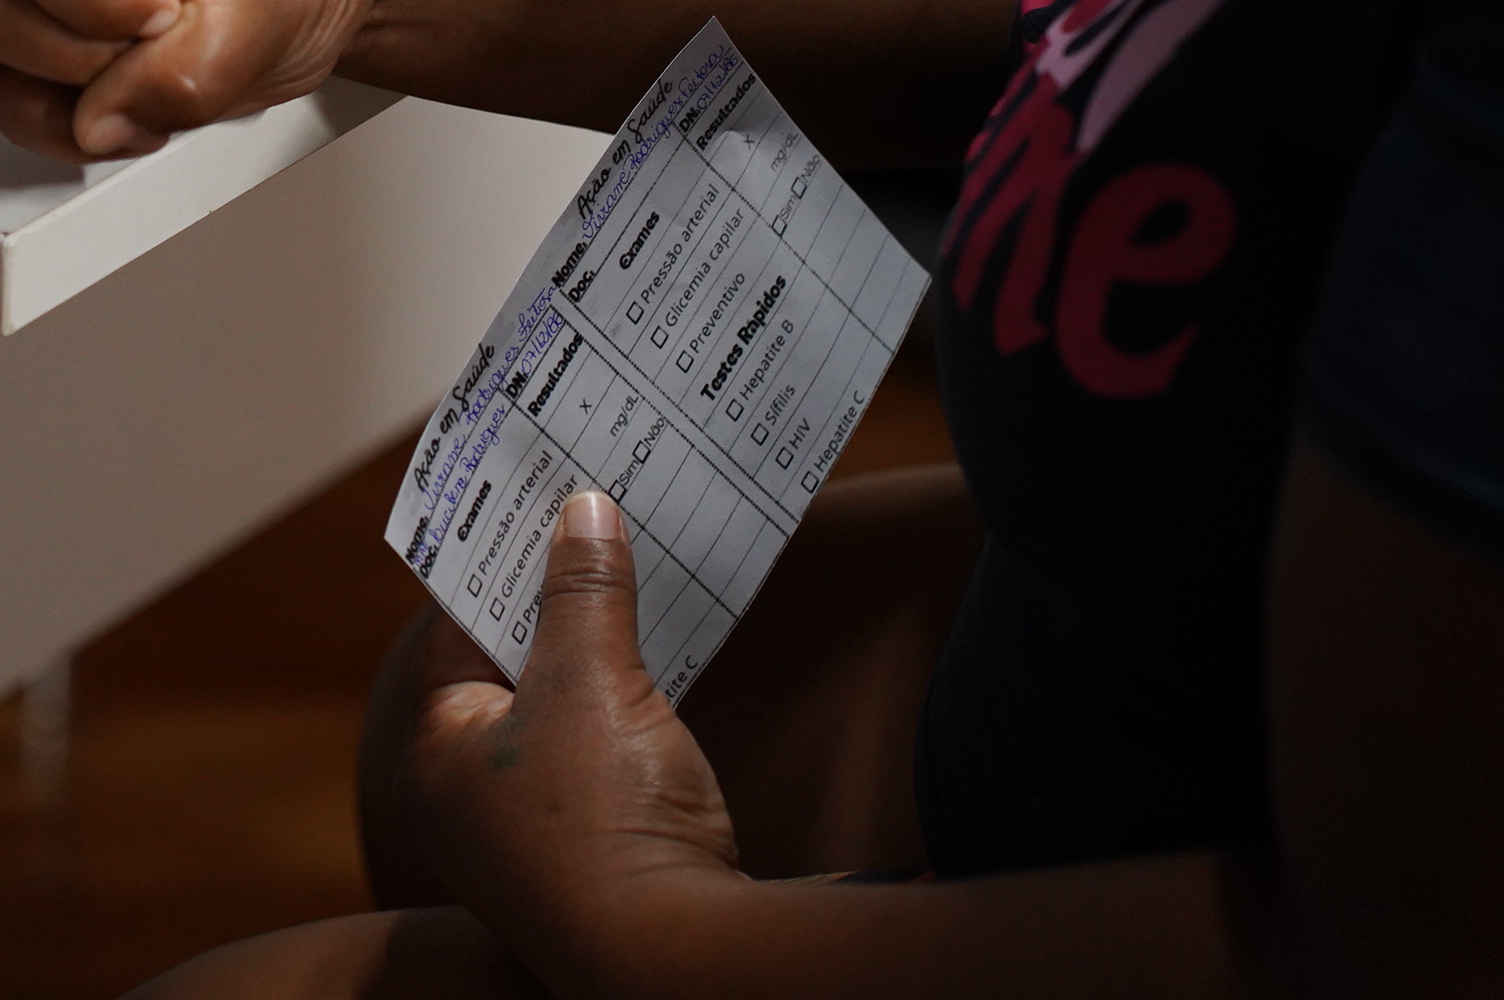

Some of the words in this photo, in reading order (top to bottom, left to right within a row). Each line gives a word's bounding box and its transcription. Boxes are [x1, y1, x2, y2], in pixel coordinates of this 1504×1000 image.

[612, 139, 631, 166] em
[627, 80, 673, 145] Saúde
[695, 73, 756, 152] Resultados
[618, 211, 660, 271] Exames
[640, 243, 683, 305] Pressão
[681, 183, 720, 243] arterial
[777, 194, 799, 222] Sim
[665, 261, 712, 327] Glicemia
[709, 208, 744, 261] capilar
[689, 273, 745, 354] Preventivo
[439, 407, 461, 435] em
[451, 342, 495, 414] Saúde
[526, 330, 585, 418] Resultados
[699, 343, 744, 401] Testes
[739, 335, 786, 401] Hepatite
[781, 319, 794, 335] B
[609, 395, 640, 437] mg/dL
[764, 384, 796, 426] Sífilis
[788, 417, 811, 451] HIV
[813, 406, 857, 472] Hepatite
[853, 390, 865, 405] C
[618, 458, 643, 487] Sim
[643, 417, 668, 447] Não
[456, 479, 492, 543] Exames
[478, 511, 515, 576] Pressão
[513, 449, 553, 511] arterial
[501, 529, 542, 599] Glicemia
[540, 474, 578, 528] capilar
[684, 654, 701, 675] C
